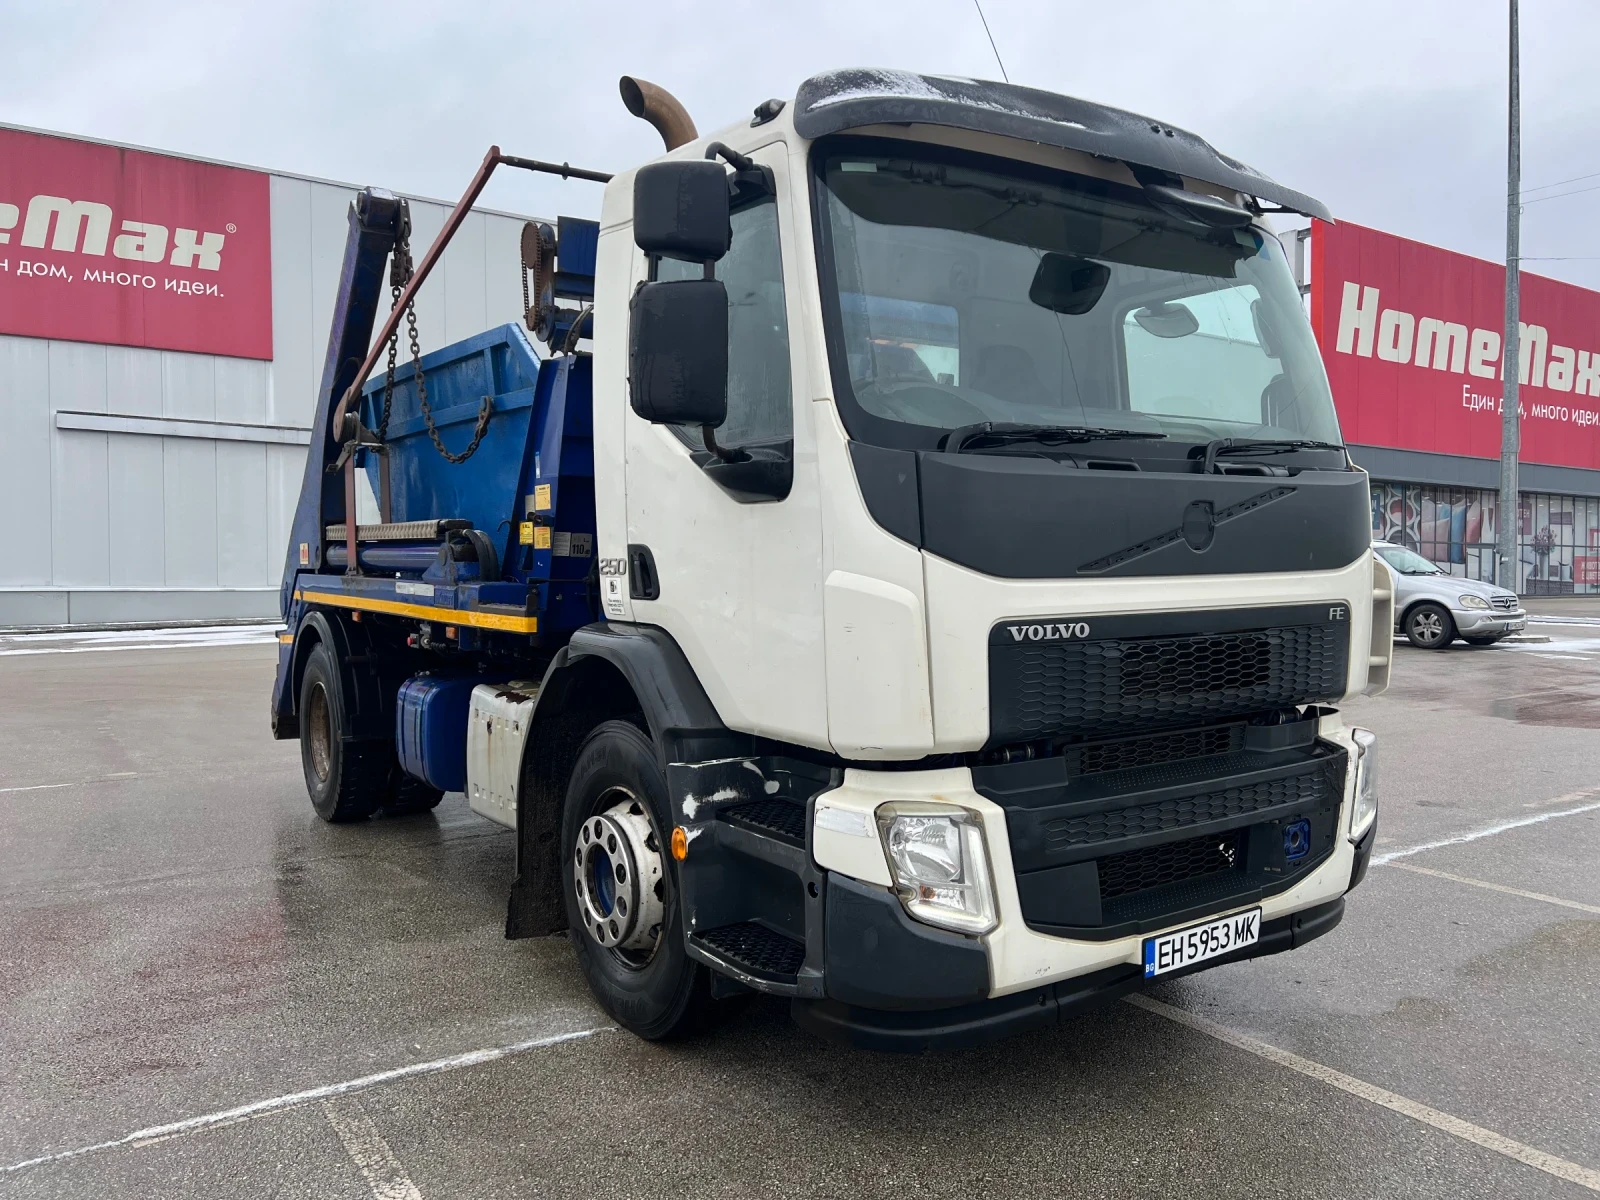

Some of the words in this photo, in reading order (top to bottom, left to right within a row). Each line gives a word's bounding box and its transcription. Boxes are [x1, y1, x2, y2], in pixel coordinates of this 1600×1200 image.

[17, 260, 75, 283] дом,
[83, 268, 156, 289] много
[164, 278, 225, 297] идеи.
[1462, 384, 1495, 412] Един
[1531, 403, 1569, 422] много
[572, 544, 585, 555] 110
[600, 558, 627, 575] 250
[1329, 607, 1345, 621] FE
[1007, 622, 1090, 641] VOLVO
[1159, 936, 1184, 969] EH
[1188, 923, 1230, 959] 5953
[1233, 914, 1257, 945] MK
[1145, 962, 1155, 973] BG
